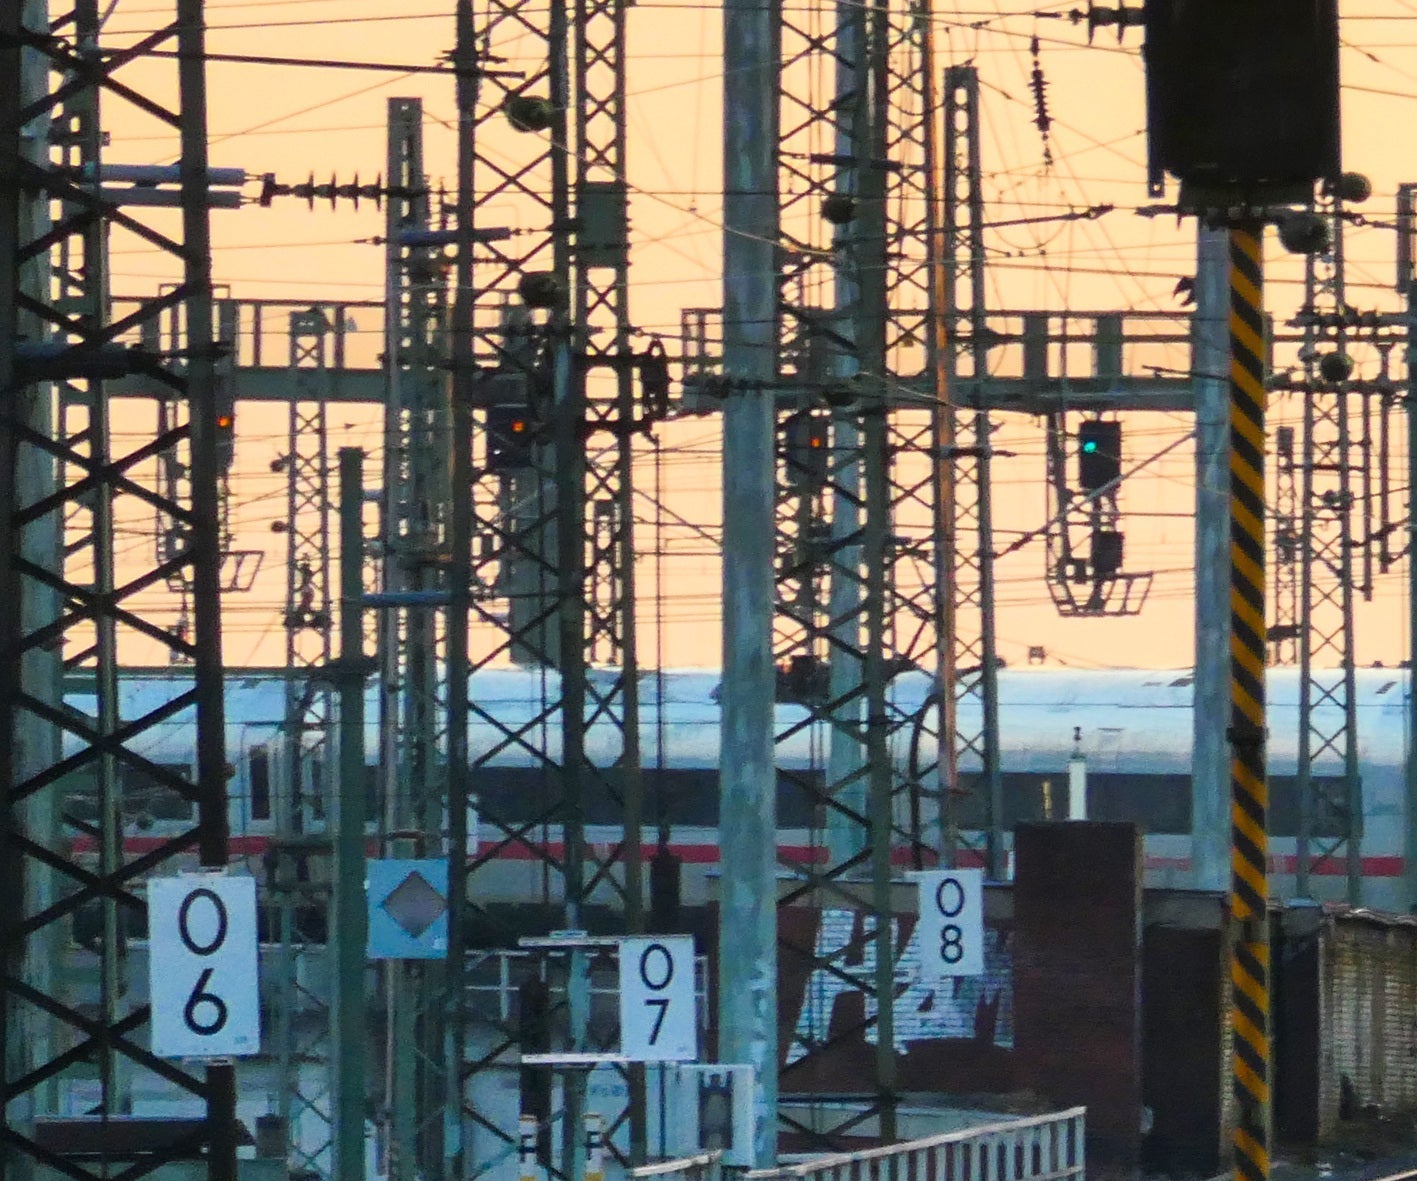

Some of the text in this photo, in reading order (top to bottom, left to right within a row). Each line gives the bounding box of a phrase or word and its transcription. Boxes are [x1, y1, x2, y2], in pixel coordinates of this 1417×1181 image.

[936, 877, 965, 917] 0
[178, 887, 228, 957] 0
[940, 924, 964, 964] 8
[639, 943, 674, 991] 0
[183, 967, 228, 1036] 6
[645, 998, 670, 1046] 7
